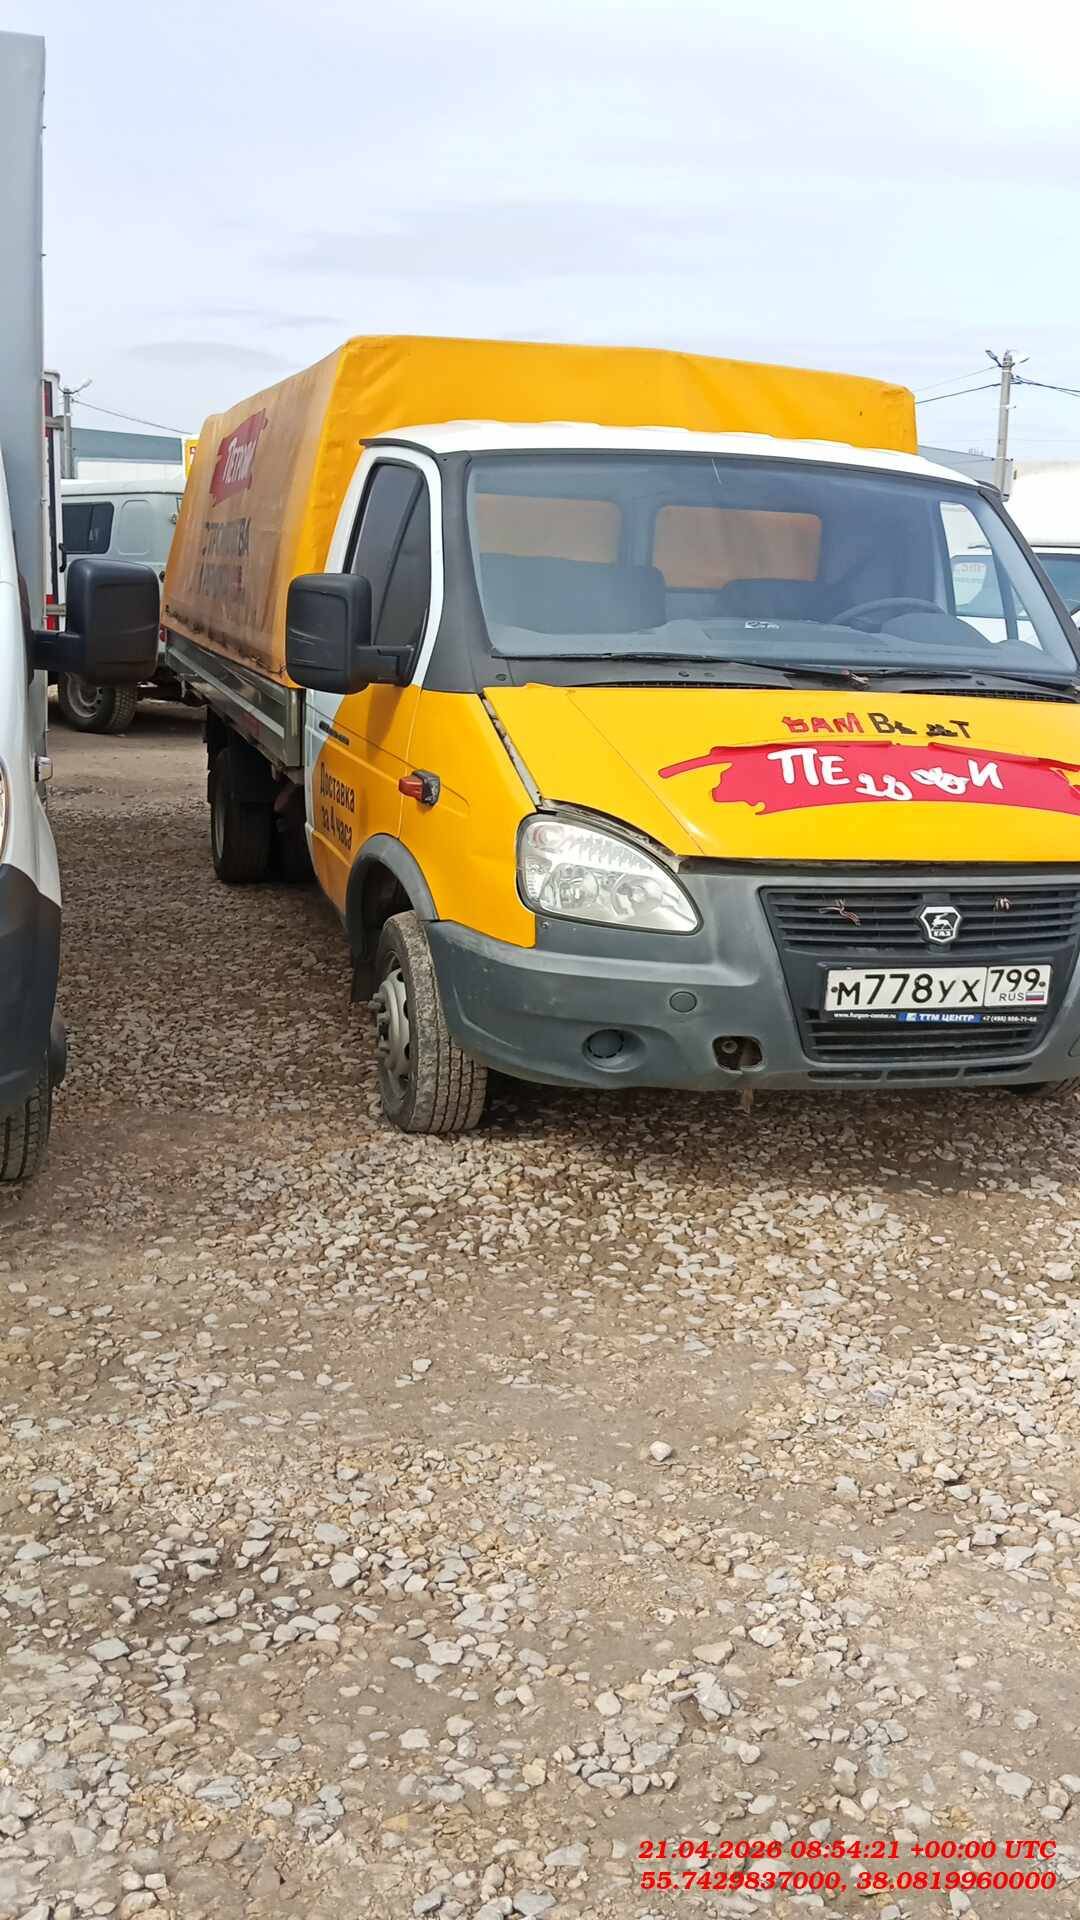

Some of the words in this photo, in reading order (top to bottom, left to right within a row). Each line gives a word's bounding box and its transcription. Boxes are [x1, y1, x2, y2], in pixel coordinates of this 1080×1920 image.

[990, 968, 1040, 993] 799
[999, 992, 1025, 1002] RUS
[941, 1013, 975, 1022] ЦЕНТР
